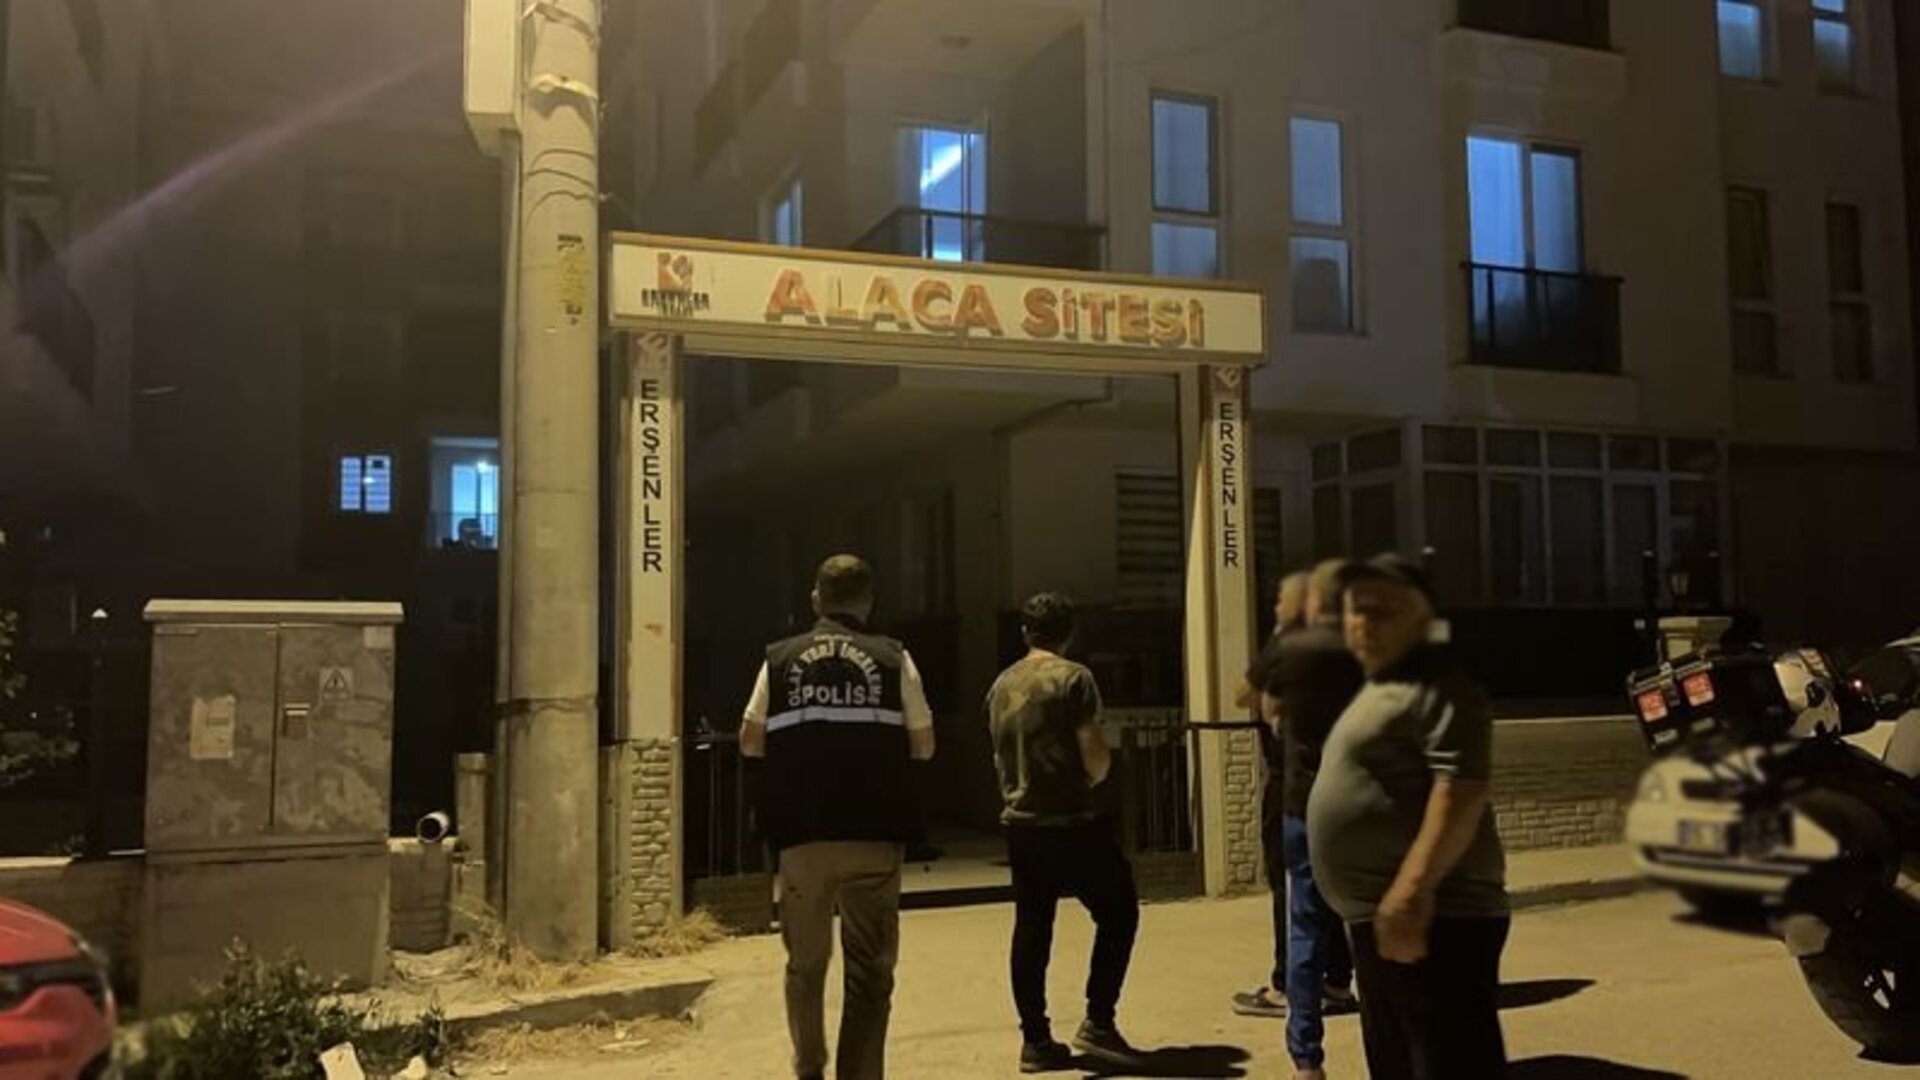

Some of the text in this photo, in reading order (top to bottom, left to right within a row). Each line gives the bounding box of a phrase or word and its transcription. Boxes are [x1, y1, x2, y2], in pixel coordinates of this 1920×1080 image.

[764, 267, 1003, 339] ALACA
[640, 378, 663, 573] ERŞENLER
[1220, 402, 1238, 568] ERŞENLER
[802, 681, 866, 705] POLİS
